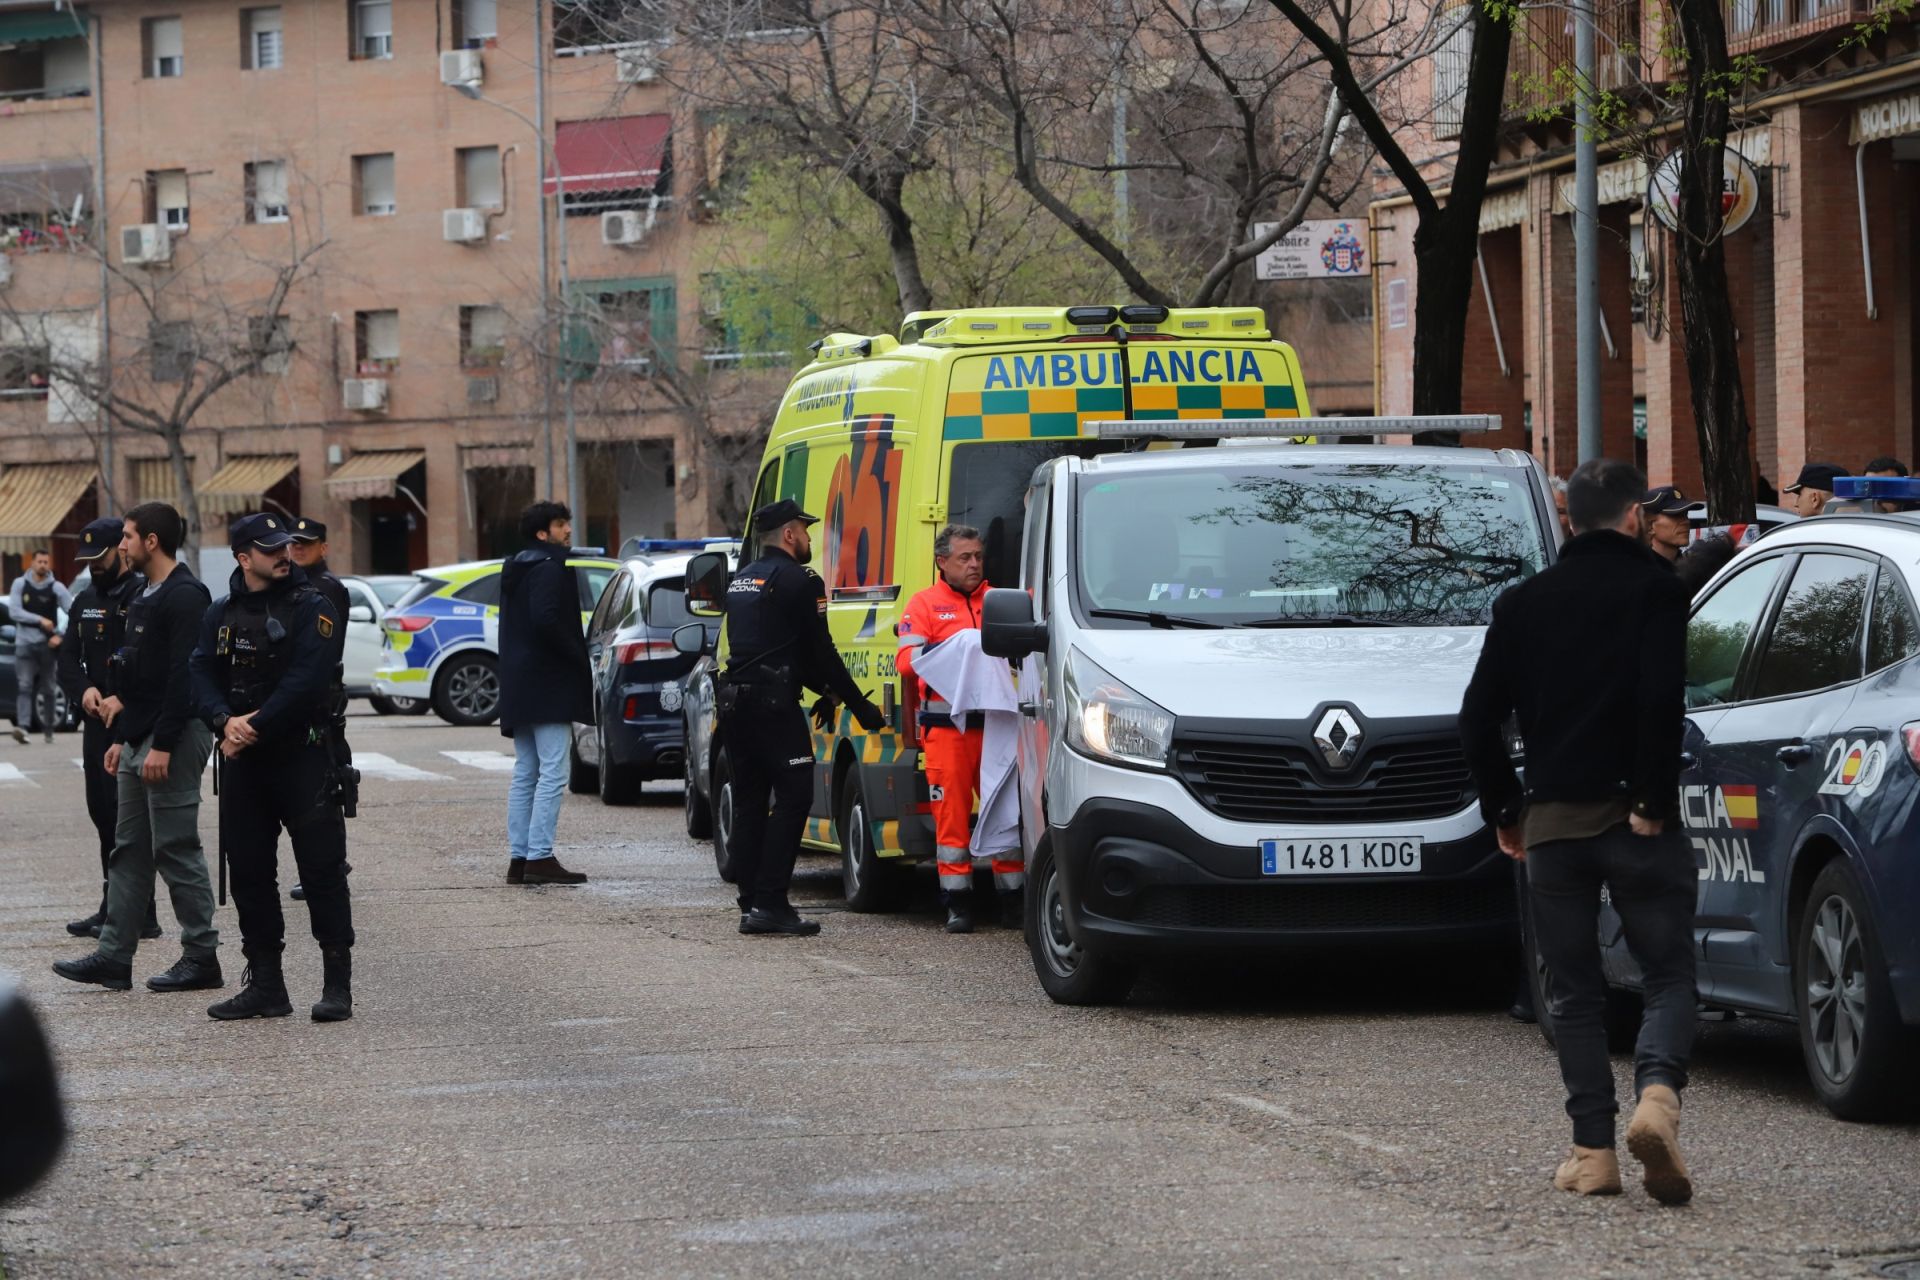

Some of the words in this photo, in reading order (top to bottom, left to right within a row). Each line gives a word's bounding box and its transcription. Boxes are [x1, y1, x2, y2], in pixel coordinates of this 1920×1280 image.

[984, 350, 1263, 389] AMBULANCIA
[823, 414, 903, 600] 061
[727, 585, 760, 593] NACIONAL
[841, 650, 869, 678] TARIAS
[1817, 738, 1887, 797] 200
[1286, 843, 1349, 869] 1481
[1363, 842, 1414, 868] KDG
[1690, 836, 1766, 883] ONAL
